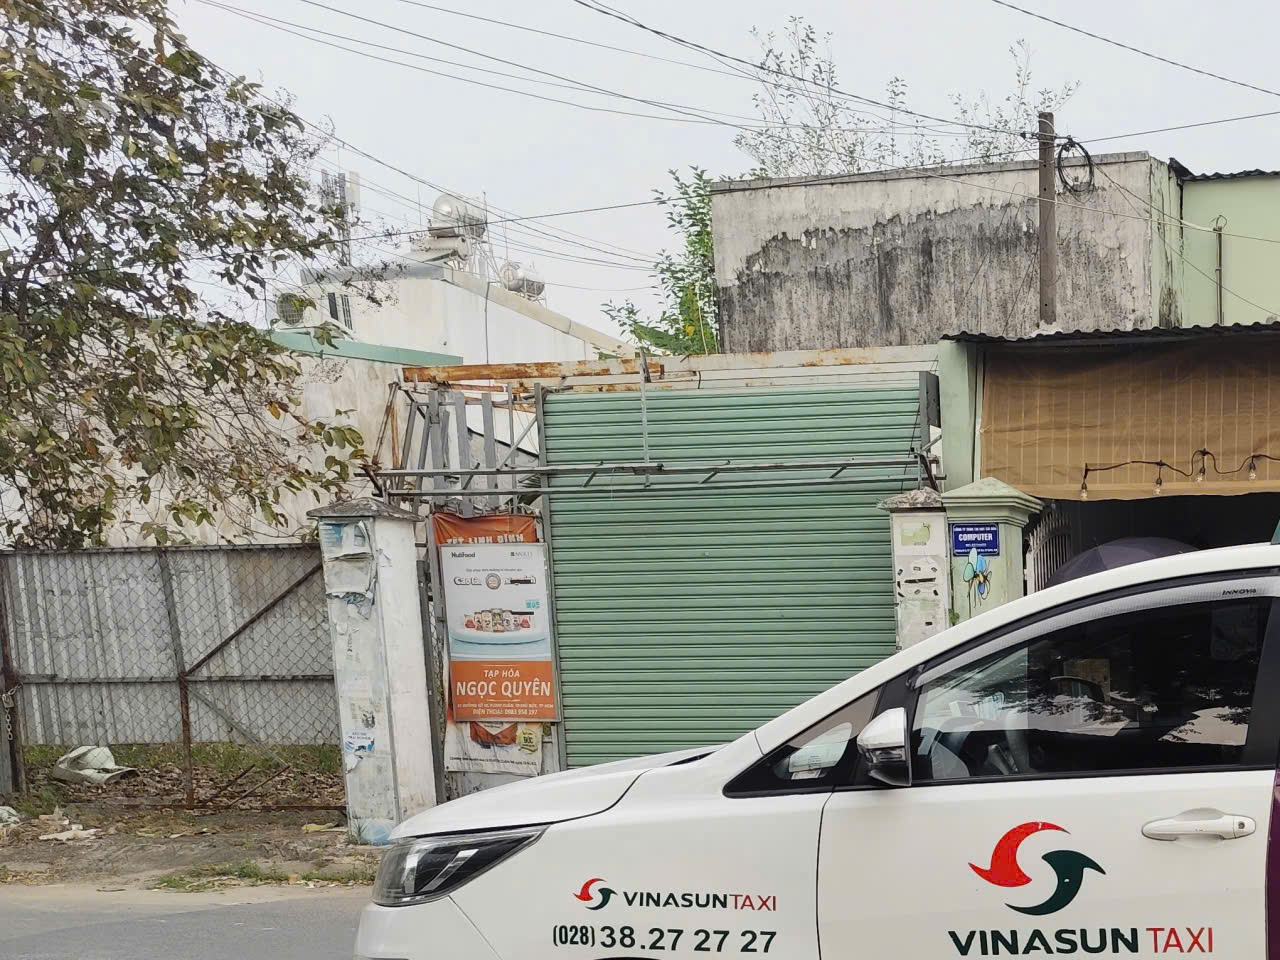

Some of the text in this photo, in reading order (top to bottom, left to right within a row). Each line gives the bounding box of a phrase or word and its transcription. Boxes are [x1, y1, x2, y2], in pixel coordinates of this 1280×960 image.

[958, 533, 993, 542] COMPUTER
[1221, 588, 1257, 596] INNOVA
[483, 669, 499, 680] TẠP
[456, 681, 497, 699] NGỌC
[623, 891, 777, 911] VINASUN TAXI
[553, 925, 596, 947] (028)
[693, 929, 730, 952] 27
[740, 930, 777, 953] 27
[948, 927, 1214, 956] VINASUN TAXI
